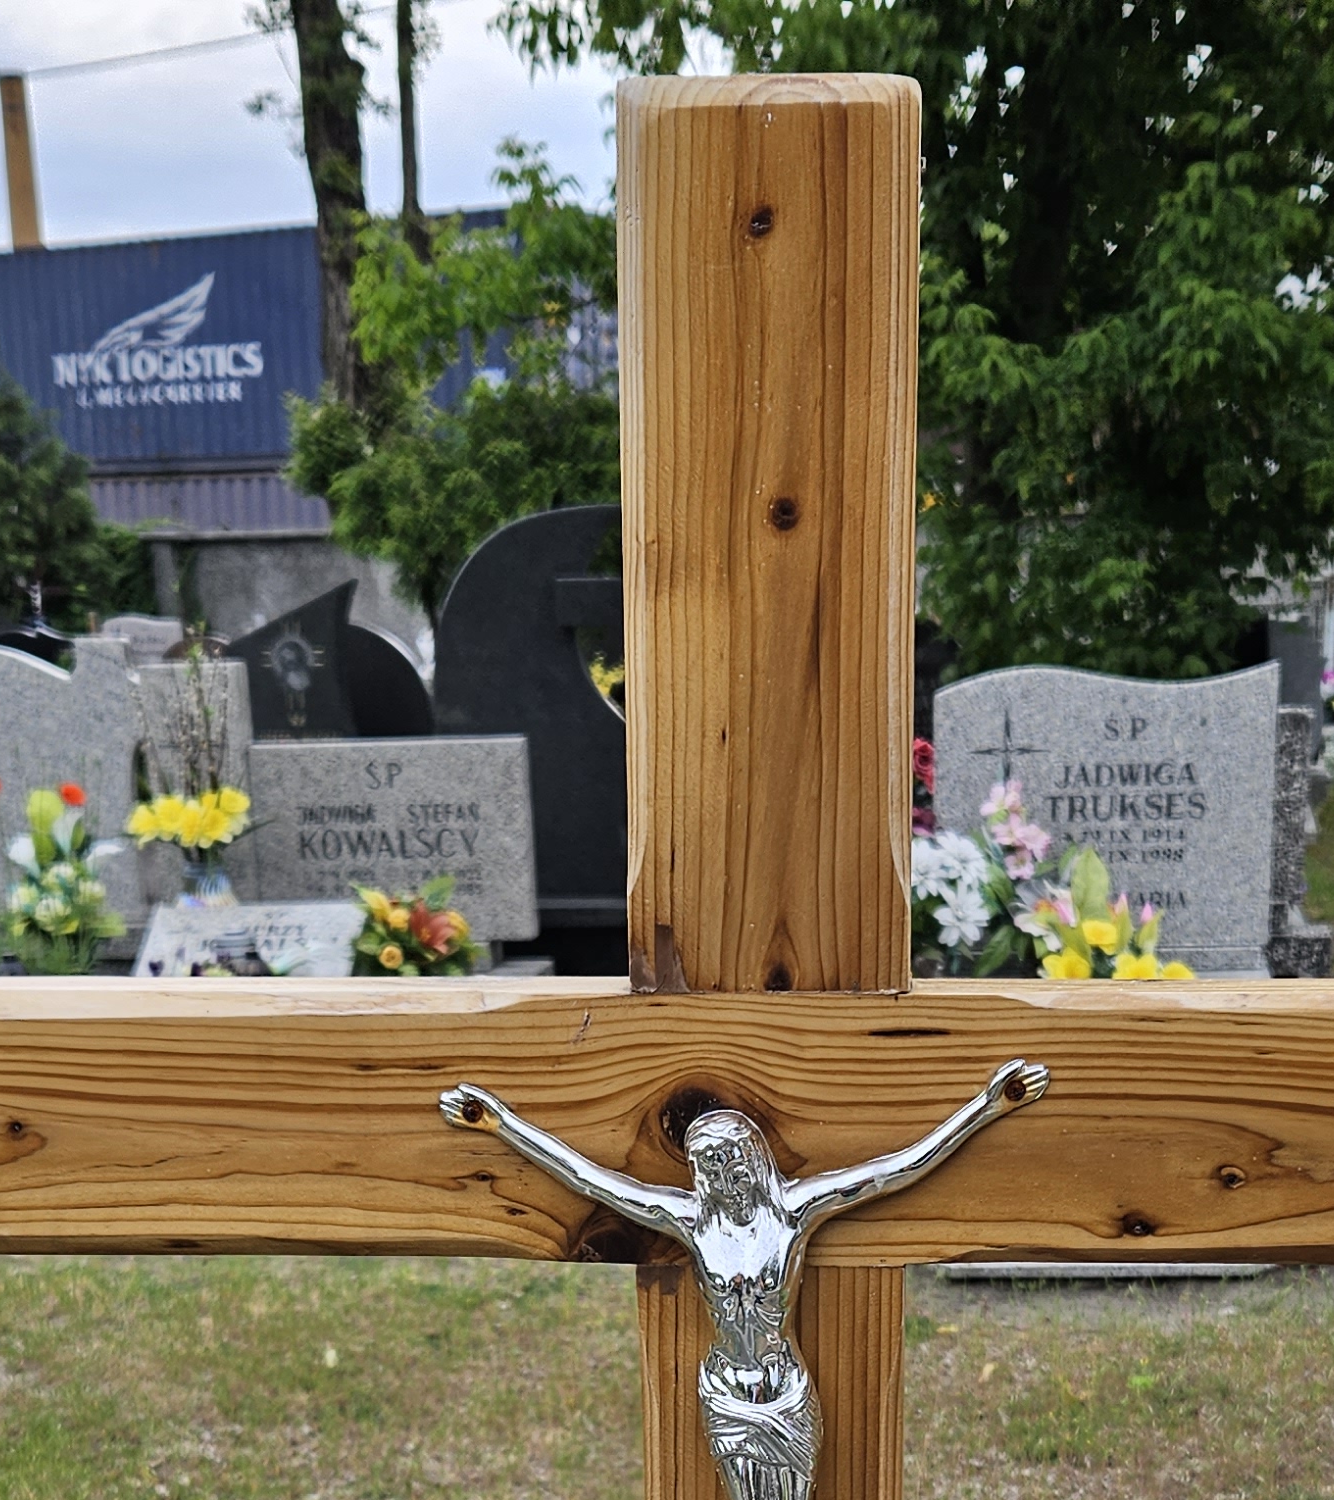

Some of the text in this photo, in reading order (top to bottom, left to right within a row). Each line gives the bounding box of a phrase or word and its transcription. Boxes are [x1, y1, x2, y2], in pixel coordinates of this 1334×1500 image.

[1054, 762, 1199, 790] JADWIGA
[1045, 792, 1208, 823] TRUKSES
[297, 827, 479, 860] KOWALSCY
